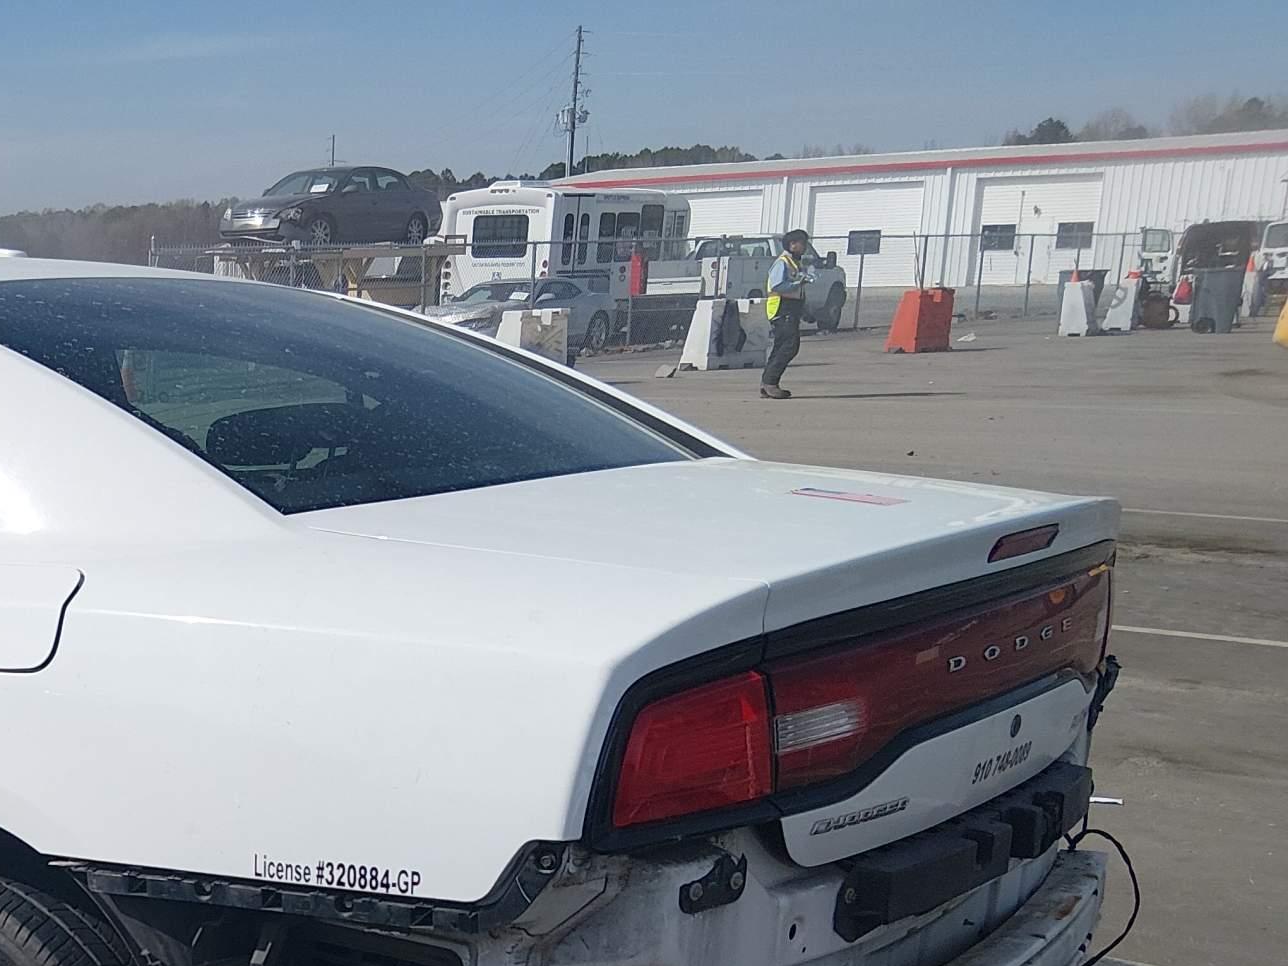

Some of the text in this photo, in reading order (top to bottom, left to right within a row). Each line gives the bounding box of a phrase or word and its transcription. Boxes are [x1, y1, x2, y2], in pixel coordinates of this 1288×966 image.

[947, 616, 1074, 673] DODGE
[972, 758, 993, 784] 910
[253, 853, 422, 895] License #320884-GP
